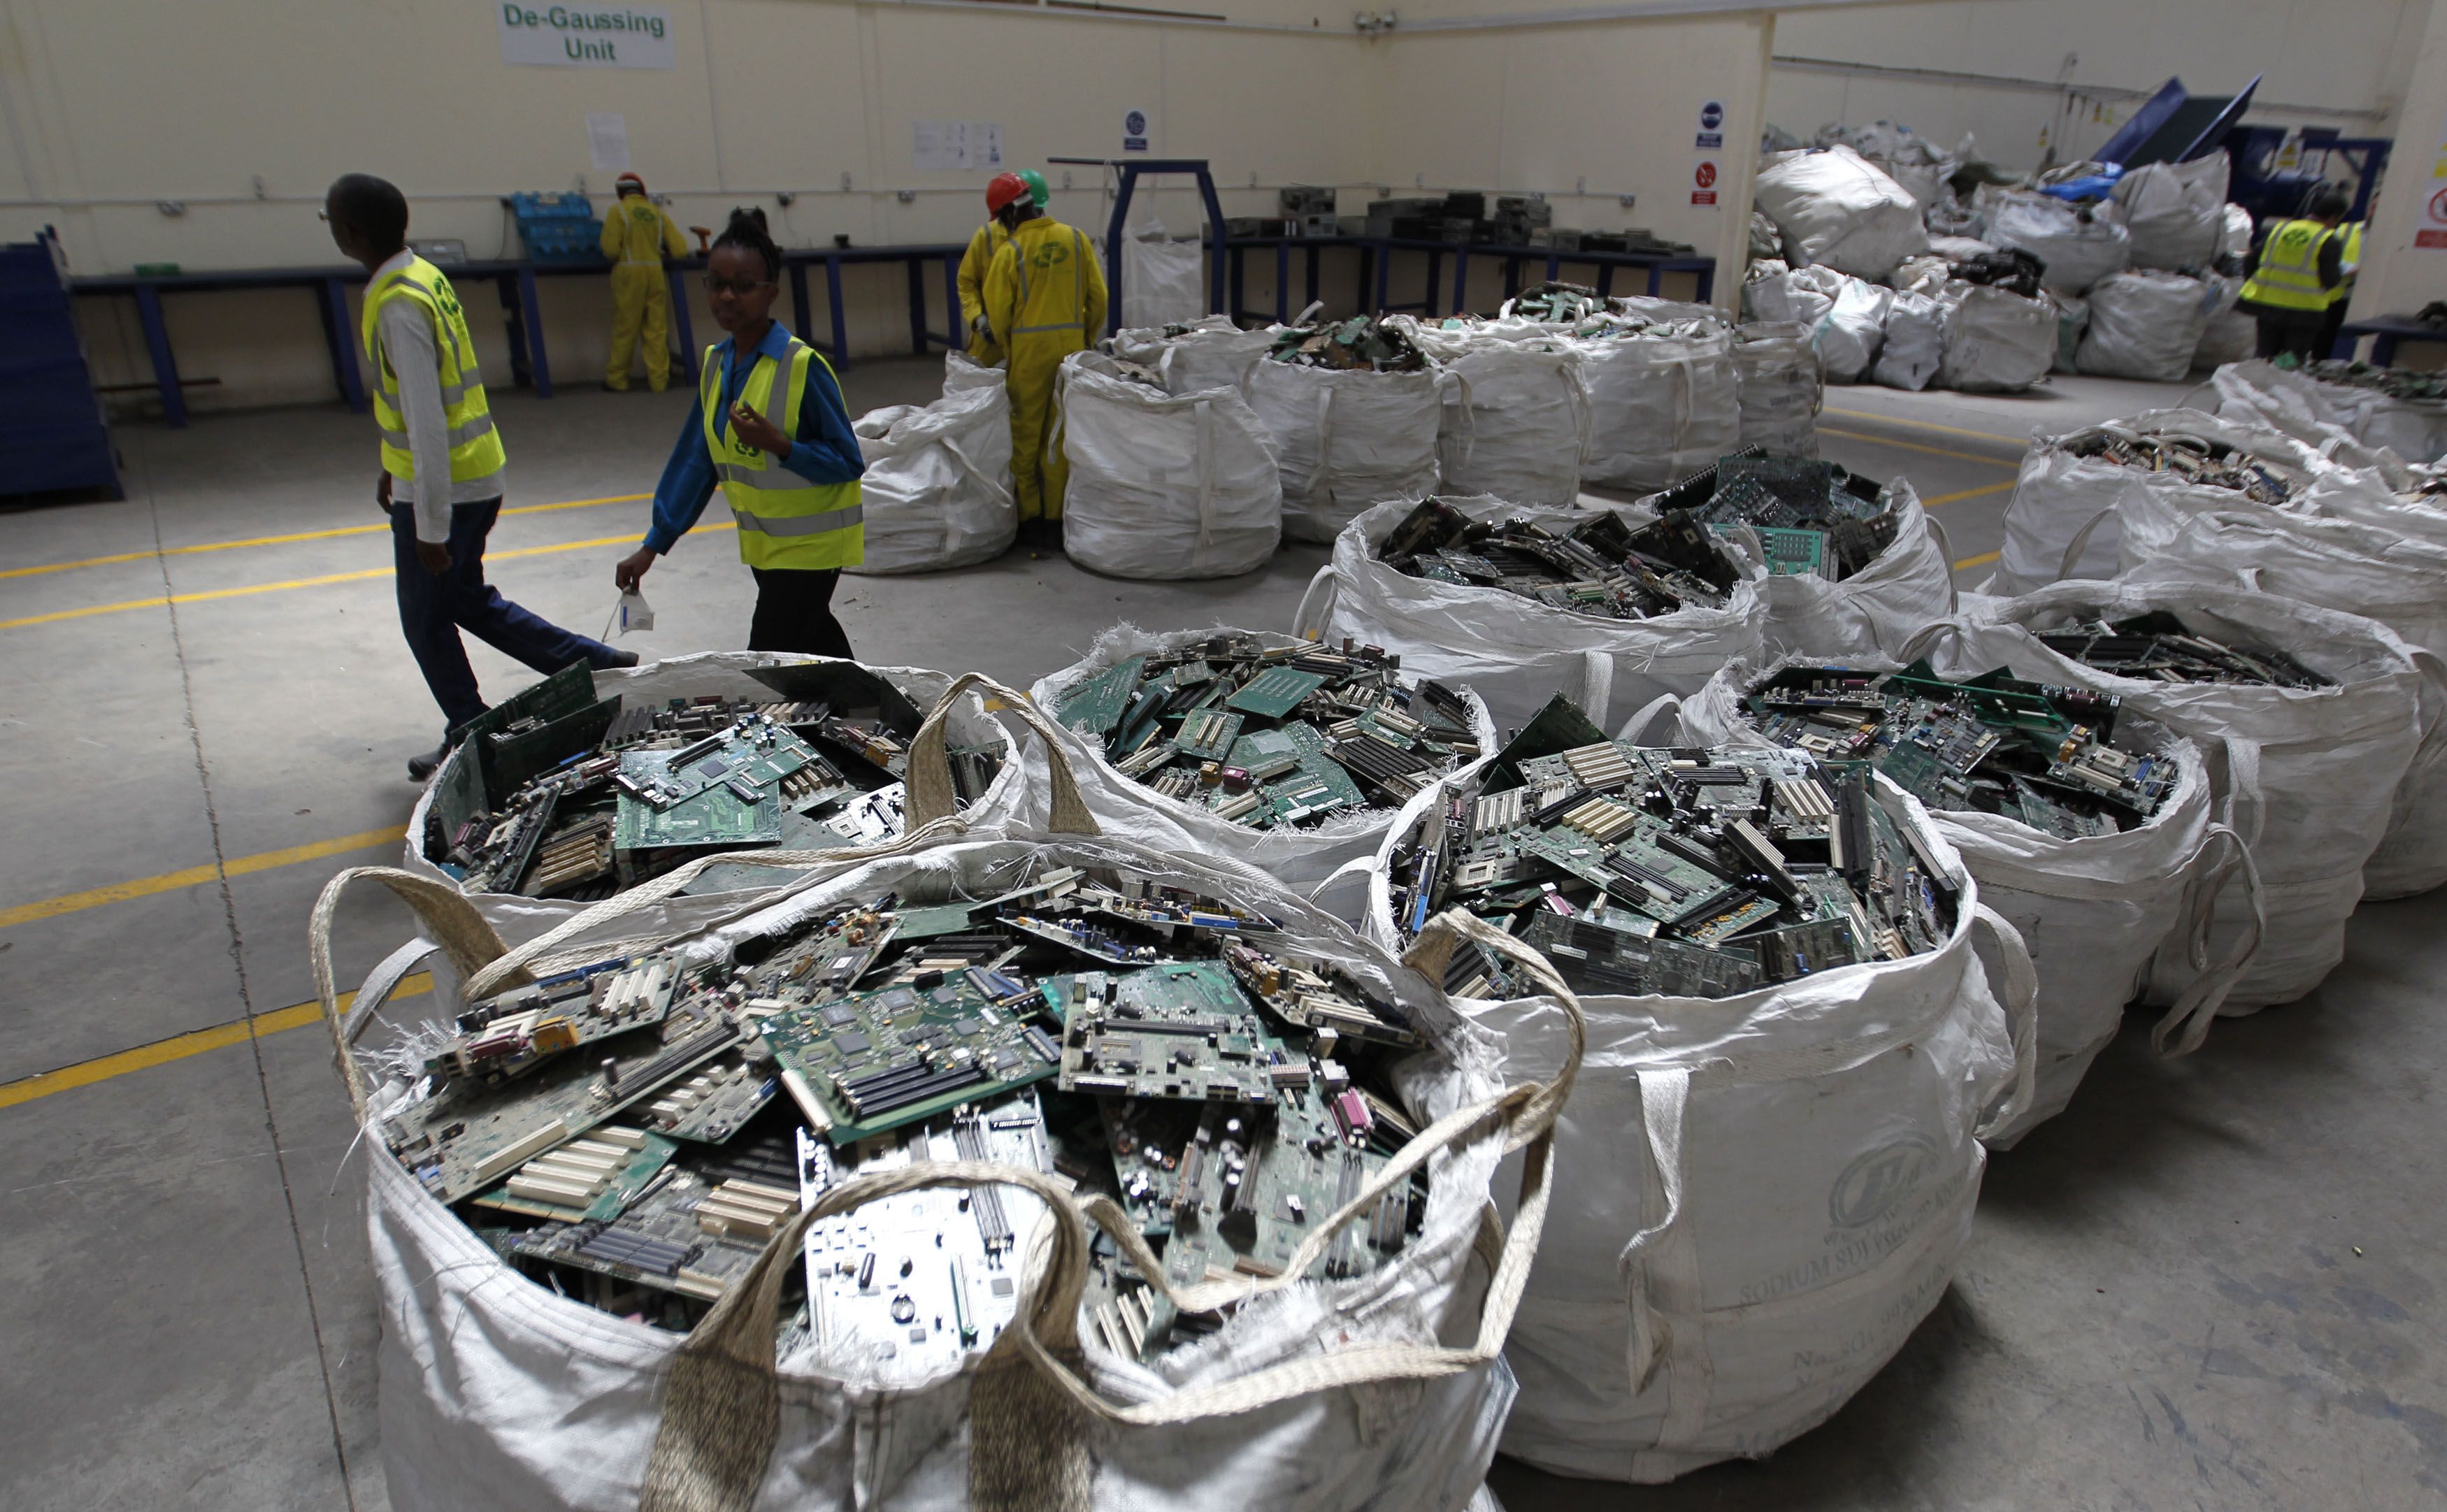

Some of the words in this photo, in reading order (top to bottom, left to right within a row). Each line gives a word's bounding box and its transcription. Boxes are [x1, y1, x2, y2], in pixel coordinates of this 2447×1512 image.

[503, 3, 664, 38] De-Gaussing
[564, 37, 616, 61] Unit
[1739, 1255, 1830, 1304] SODIUM
